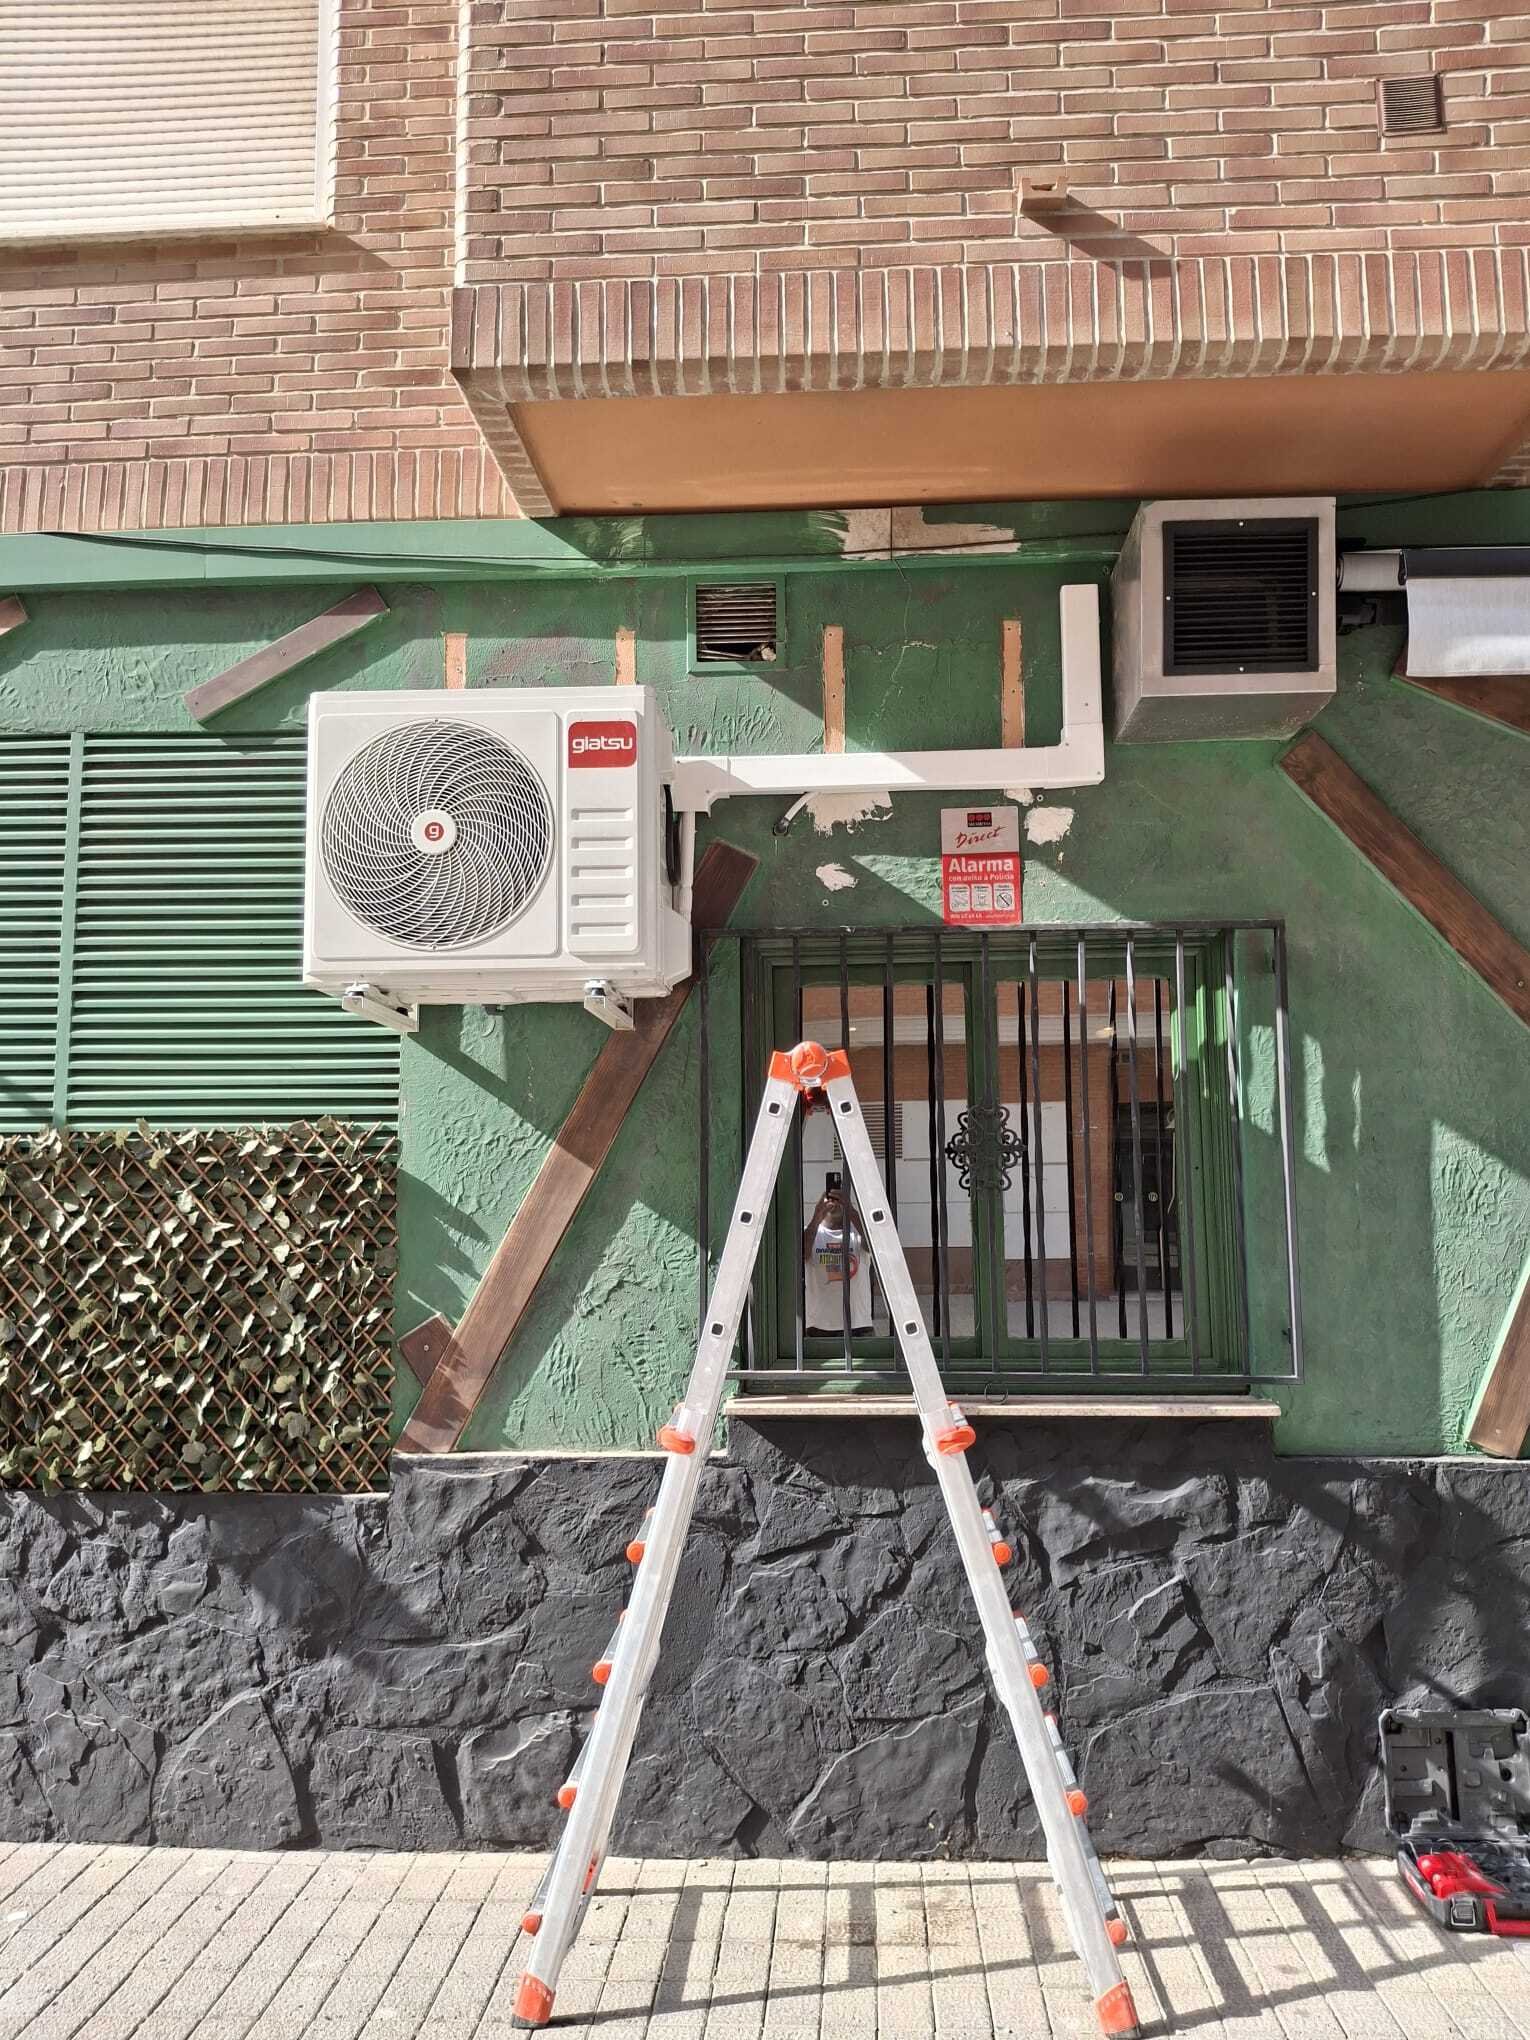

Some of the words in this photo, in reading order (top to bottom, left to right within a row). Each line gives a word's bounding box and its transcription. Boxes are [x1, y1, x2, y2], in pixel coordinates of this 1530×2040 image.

[572, 736, 633, 753] giatsu
[955, 826, 1006, 848] Direct
[949, 857, 1014, 873] Alarma
